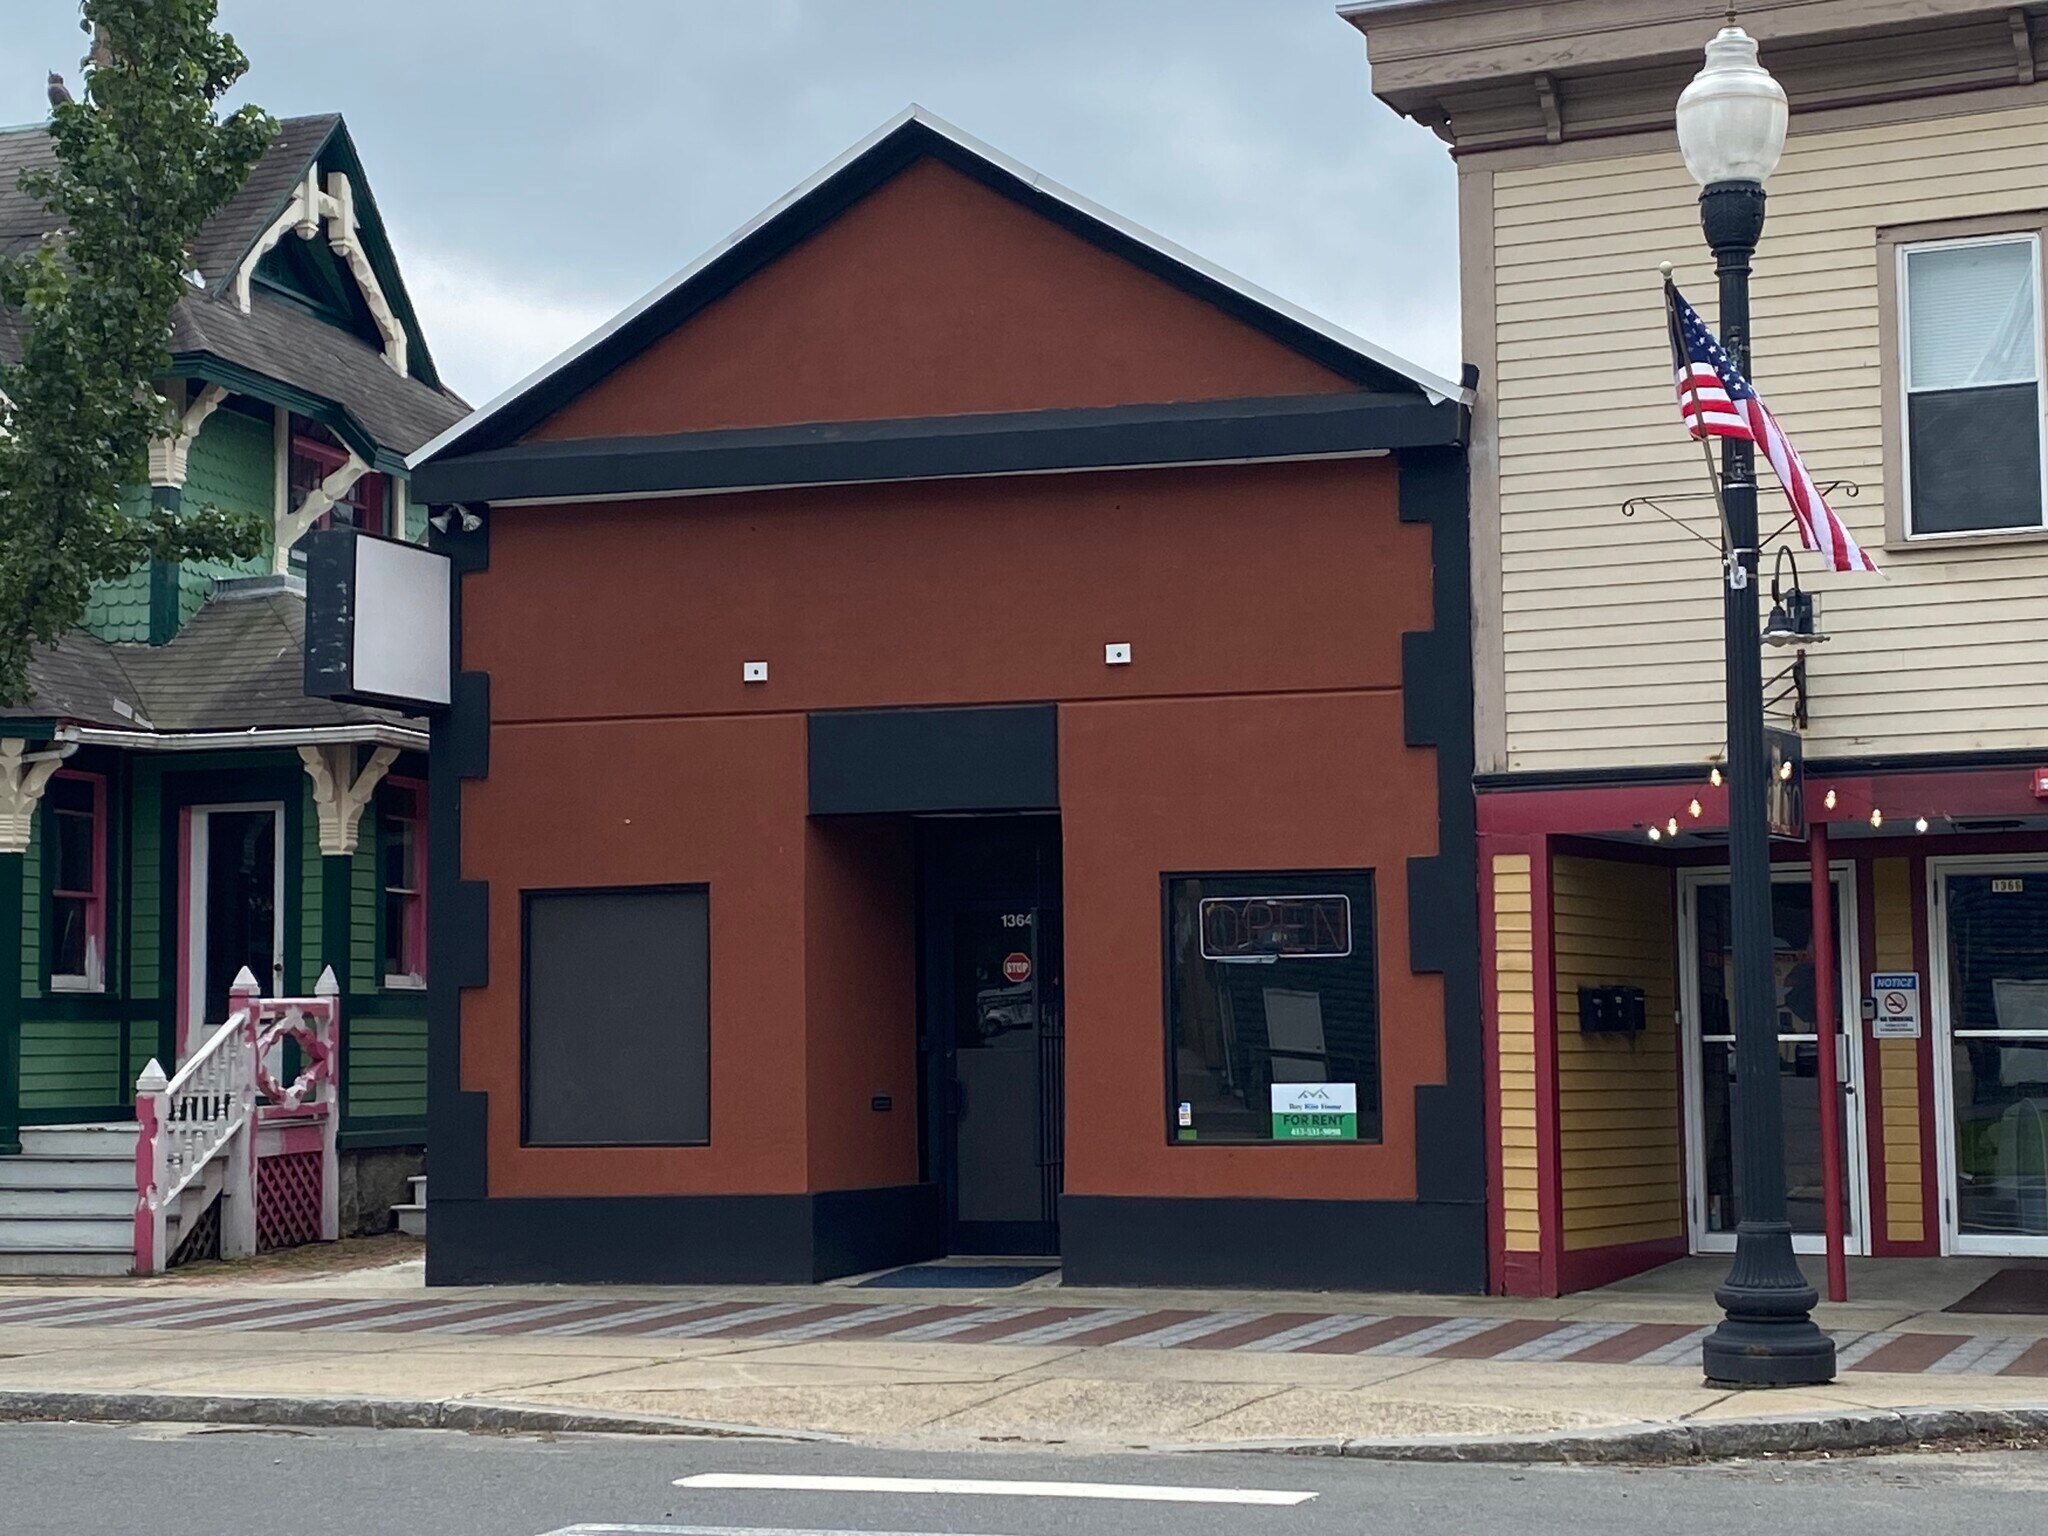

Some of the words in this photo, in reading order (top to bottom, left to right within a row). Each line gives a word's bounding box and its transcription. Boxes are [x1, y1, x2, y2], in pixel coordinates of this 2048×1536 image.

[1001, 914, 1032, 927] 1364
[1206, 901, 1346, 952] OPEN
[1006, 962, 1028, 973] STOP
[1877, 978, 1914, 988] NOTICE
[1283, 1115, 1308, 1126] FOR
[1312, 1115, 1345, 1126] RENT
